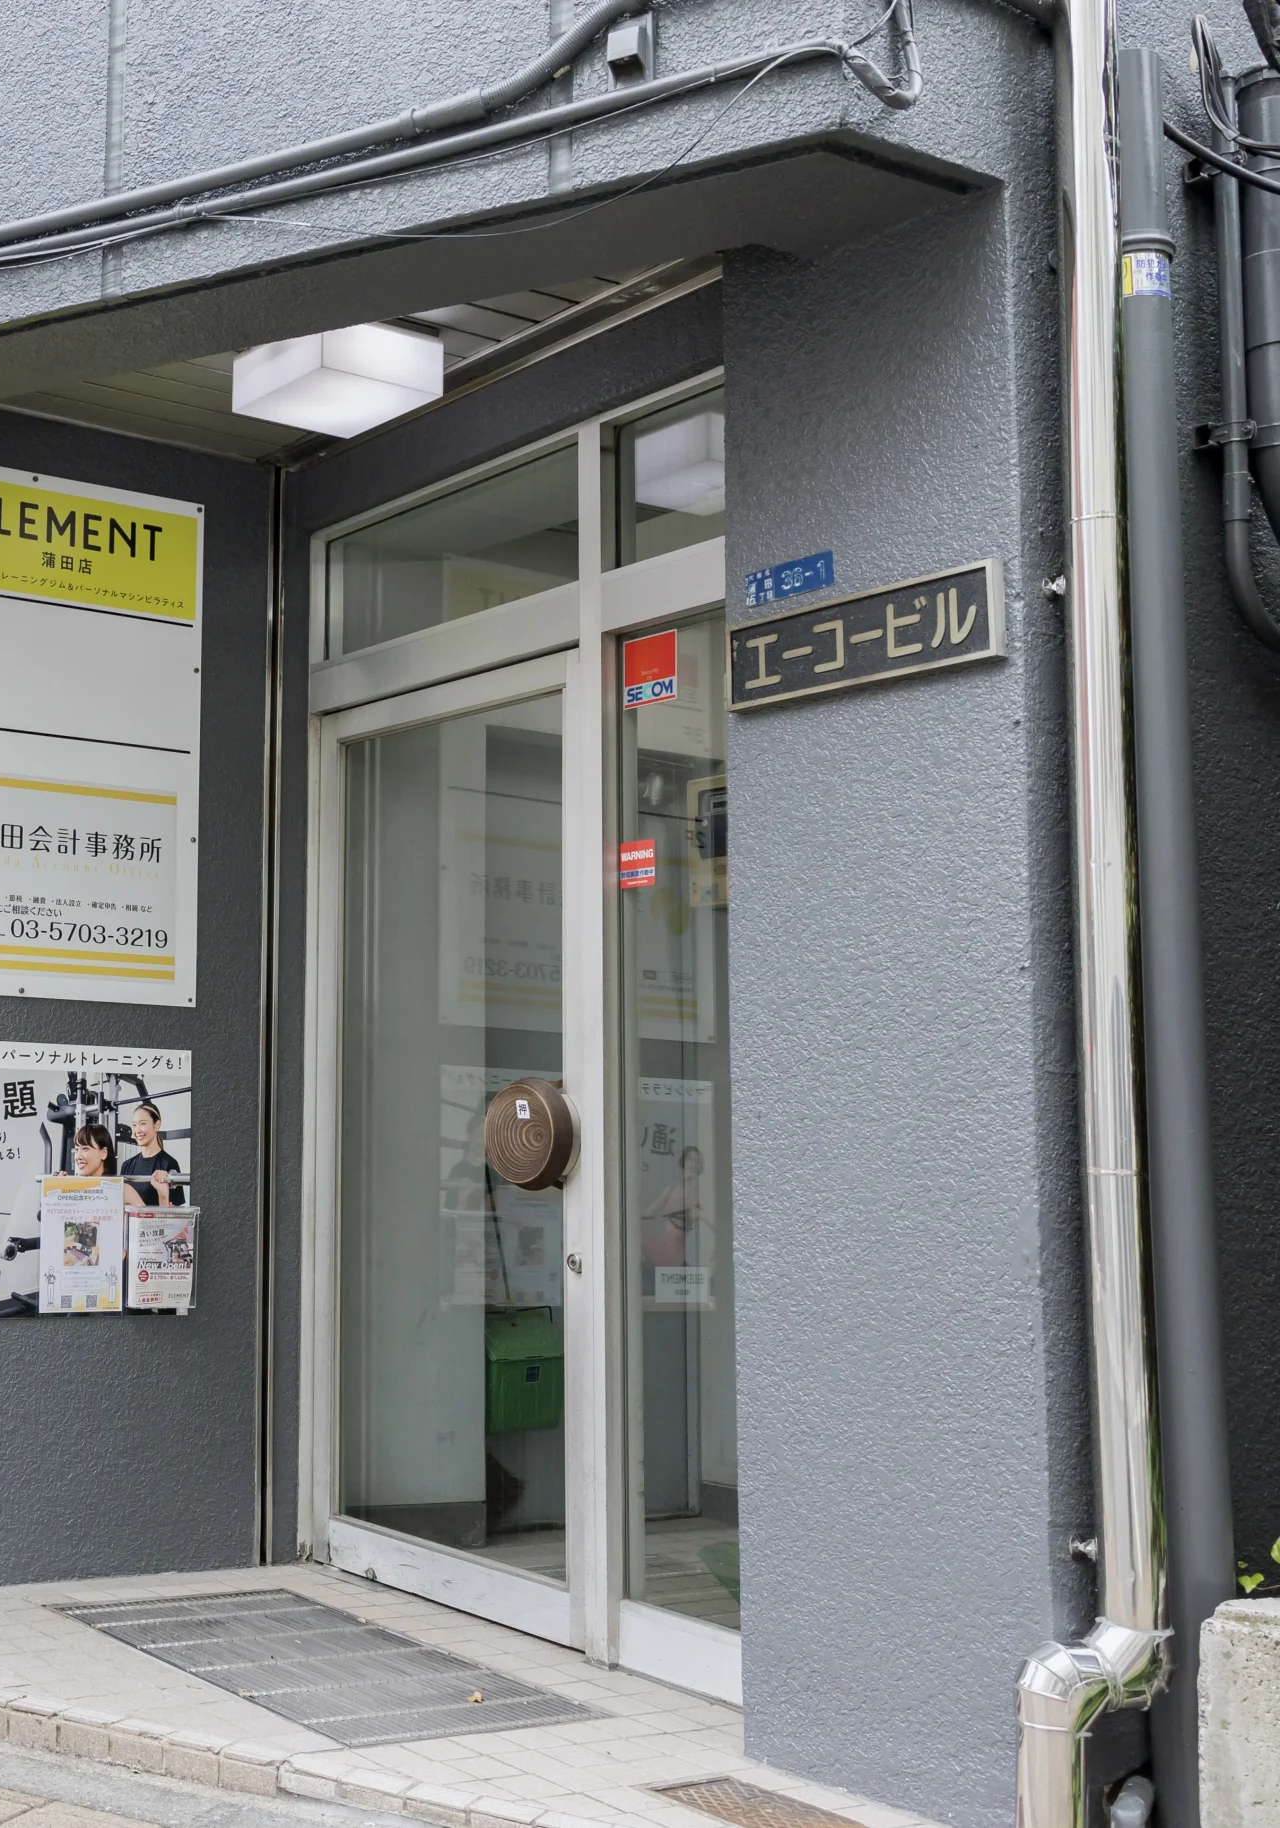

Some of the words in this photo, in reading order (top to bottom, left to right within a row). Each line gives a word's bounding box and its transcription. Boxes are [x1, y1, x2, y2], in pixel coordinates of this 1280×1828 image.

[41, 551, 93, 575] 蒲田店
[781, 560, 826, 590] 36-1
[745, 587, 977, 690] エーコービル
[627, 679, 673, 703] SECOM
[621, 848, 654, 862] WARNING
[10, 918, 168, 948] 03-5703-3219
[2, 1049, 184, 1070] パーソナルトレーニングも!
[518, 1103, 527, 1115] 押
[137, 1260, 159, 1269] New
